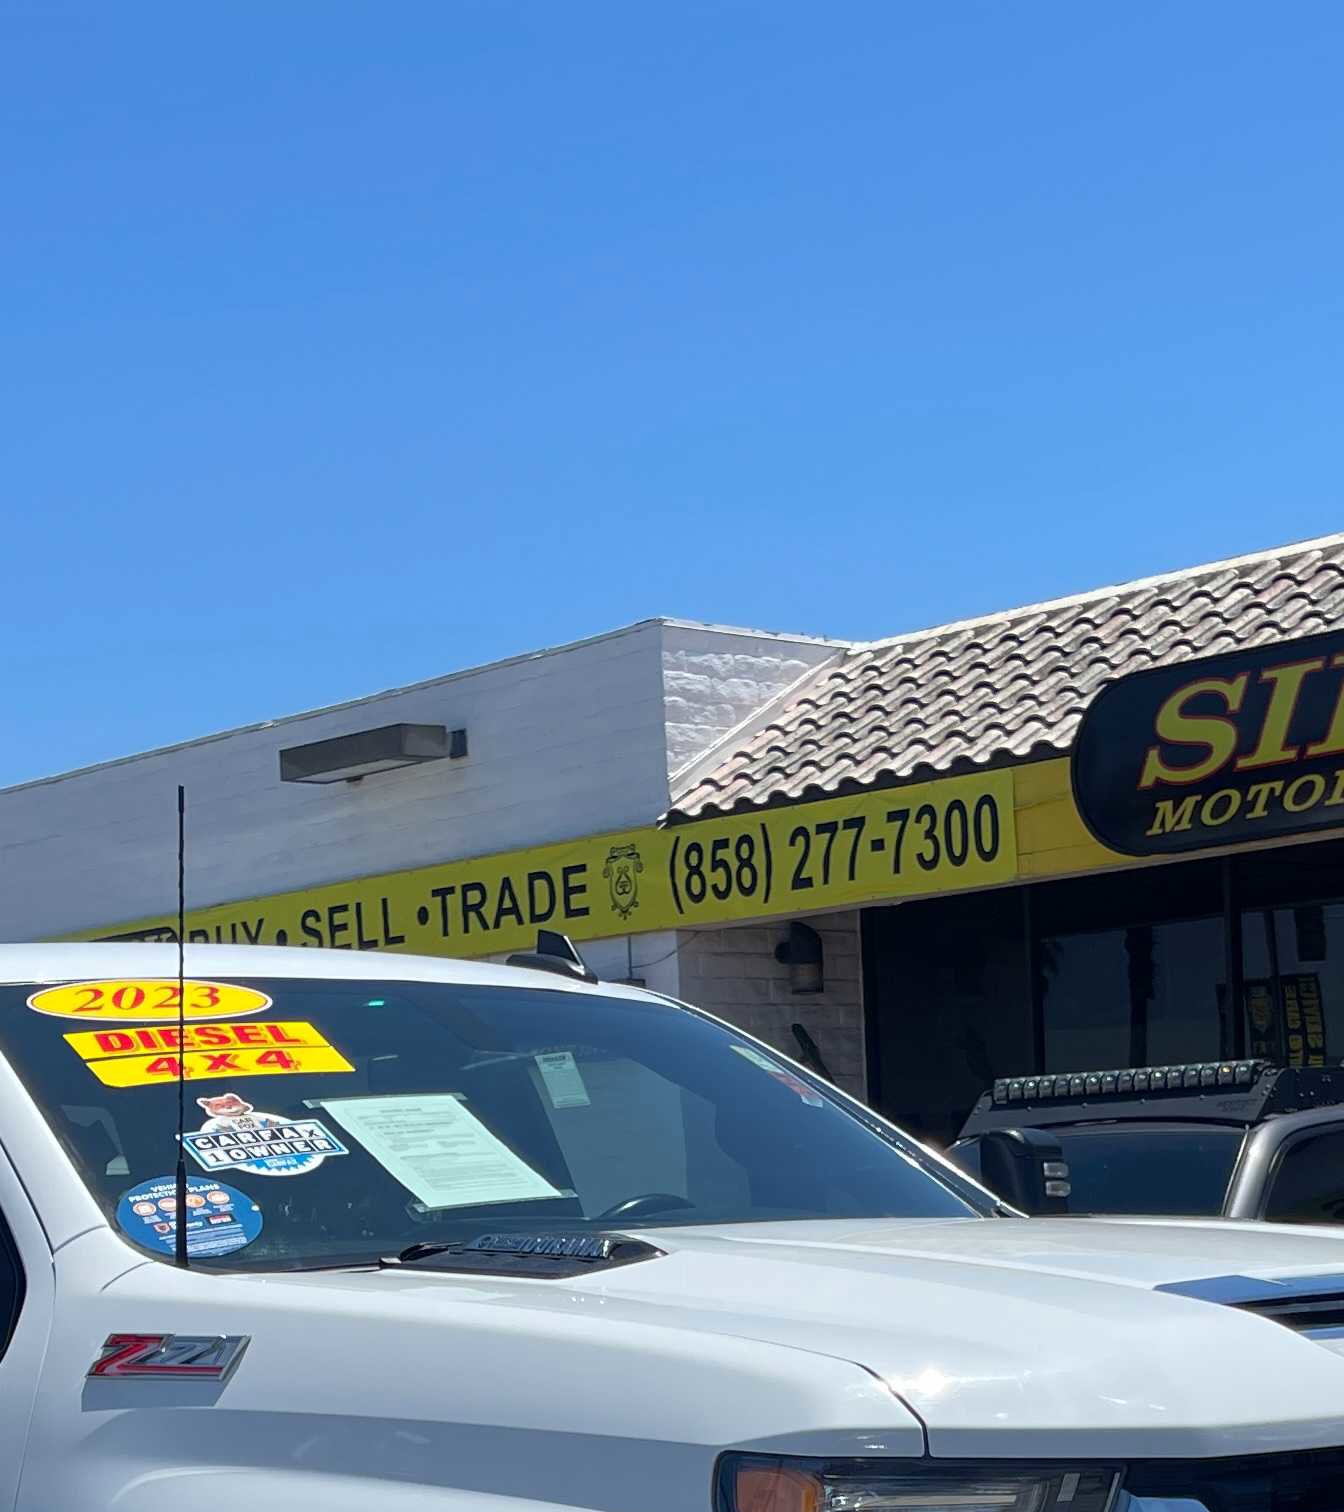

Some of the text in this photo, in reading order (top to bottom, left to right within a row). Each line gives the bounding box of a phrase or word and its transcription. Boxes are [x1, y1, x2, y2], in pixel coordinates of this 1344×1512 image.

[669, 794, 1000, 914] (858) 277-7300
[301, 897, 405, 949] SELL
[431, 863, 591, 937] TRADE
[71, 986, 221, 1012] 2023
[93, 1025, 302, 1054] DIESEL
[194, 1125, 322, 1150] CARFAX
